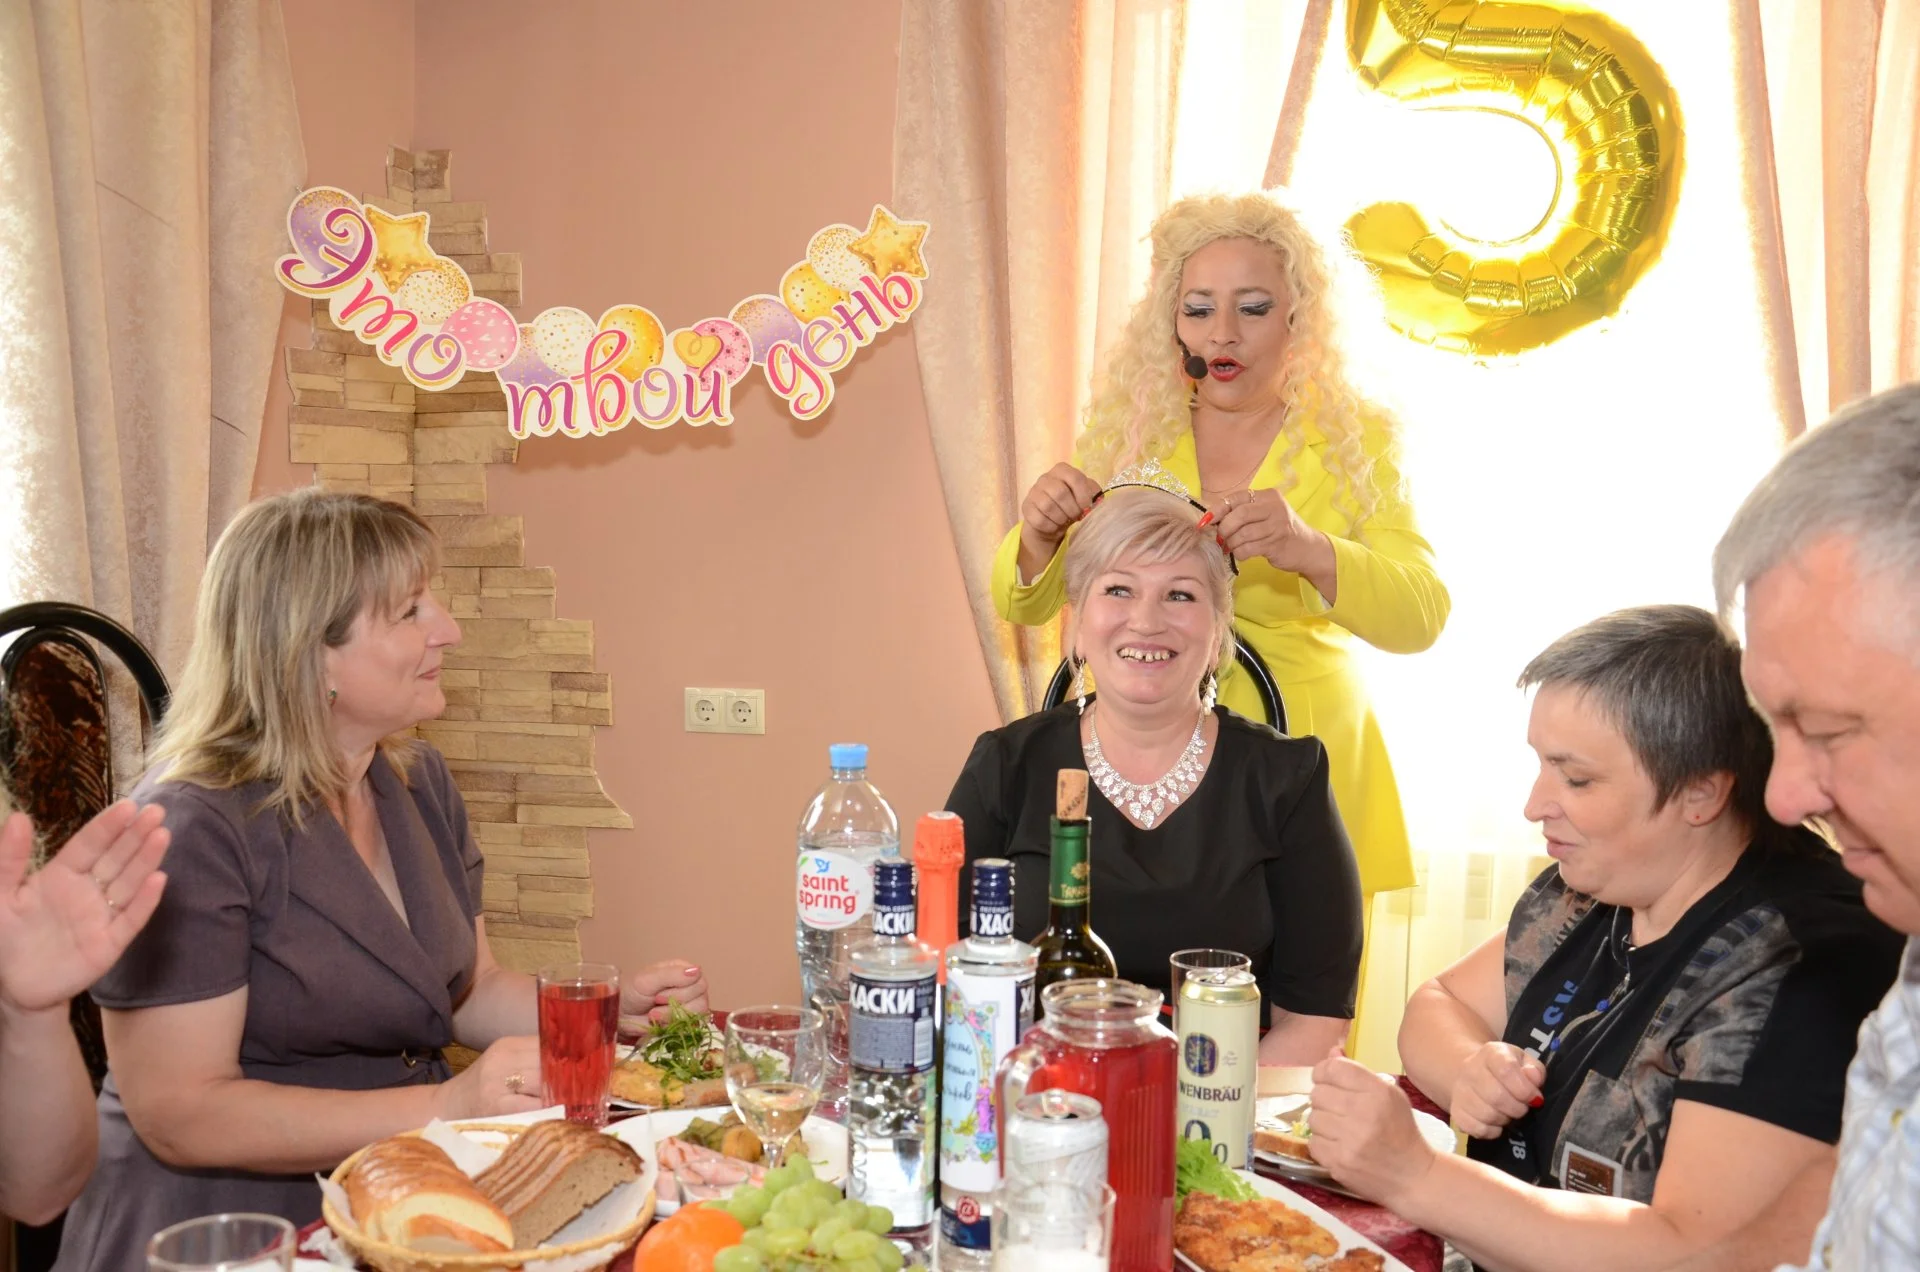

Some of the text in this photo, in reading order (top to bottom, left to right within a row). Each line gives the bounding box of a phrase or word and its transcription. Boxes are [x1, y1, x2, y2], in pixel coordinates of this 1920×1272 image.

[280, 207, 918, 436] Это твой день
[802, 874, 849, 892] saint
[799, 889, 856, 915] spring
